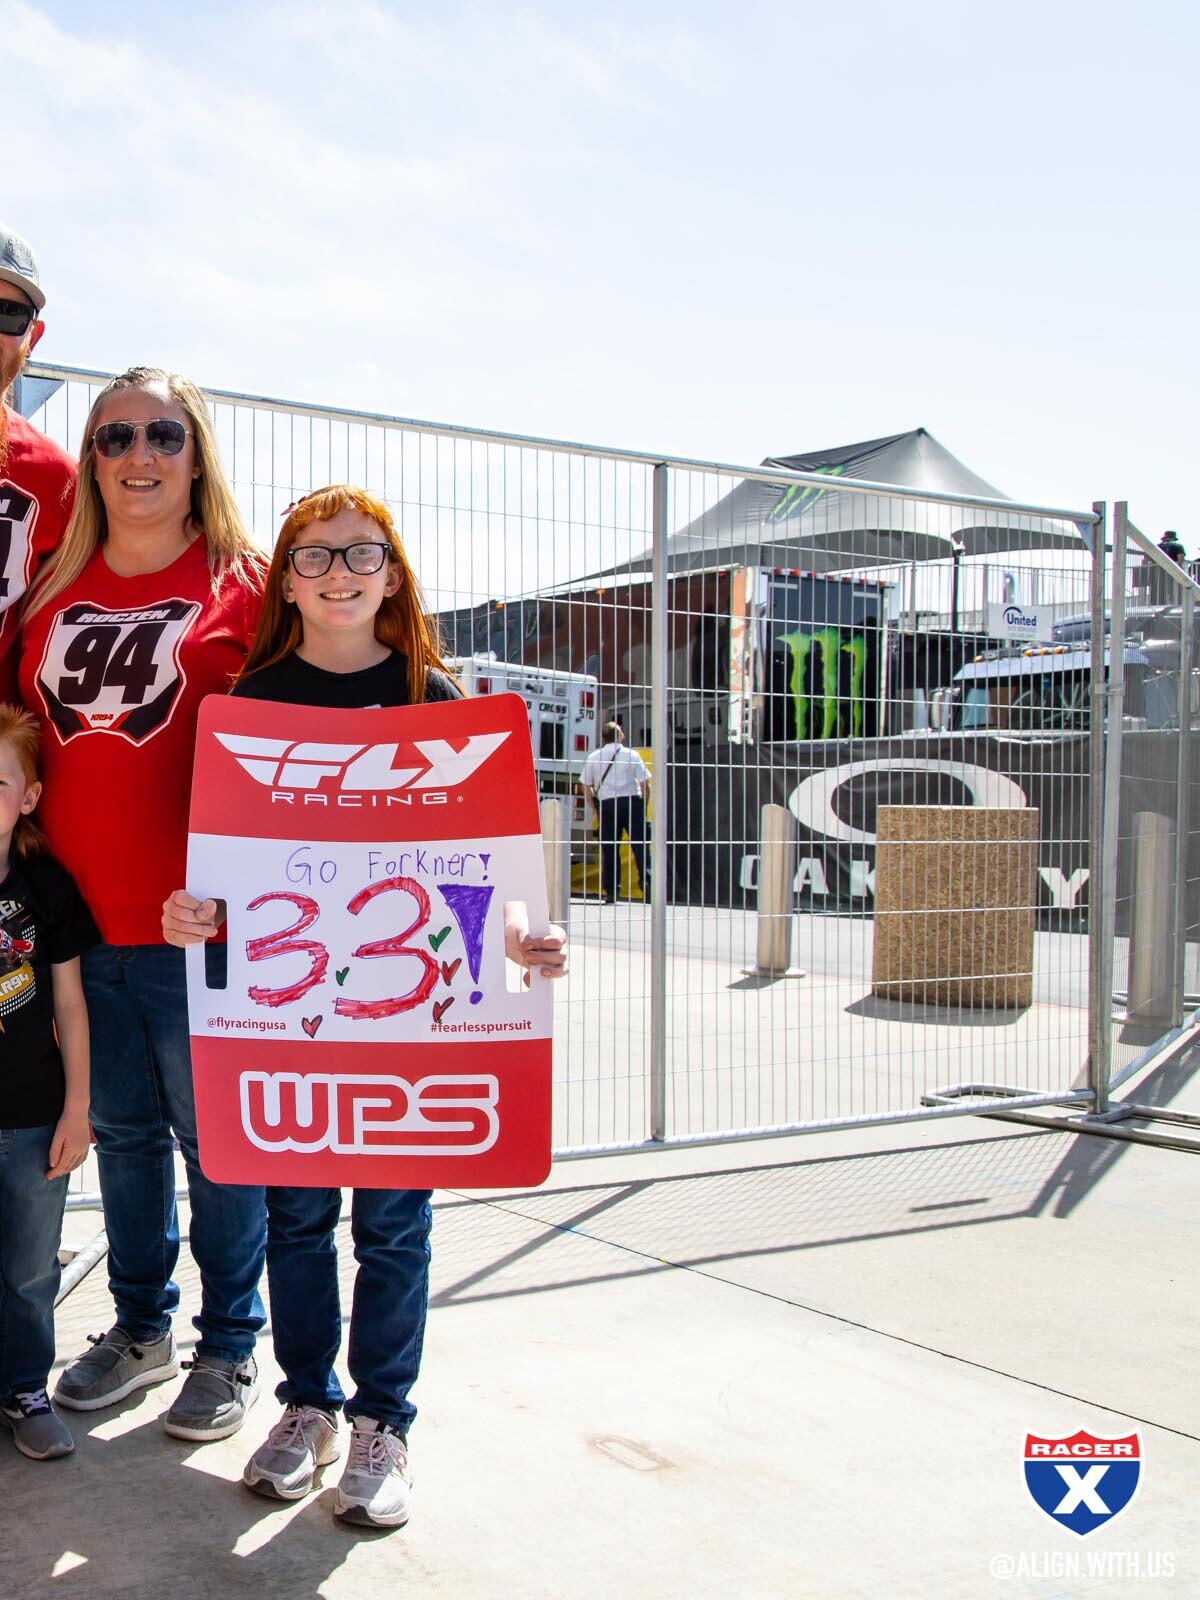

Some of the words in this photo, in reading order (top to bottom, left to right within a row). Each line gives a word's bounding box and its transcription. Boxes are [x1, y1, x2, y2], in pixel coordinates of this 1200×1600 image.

[75, 608, 171, 623] ROCZEN
[1006, 612, 1037, 626] United
[58, 622, 168, 705] 94
[212, 731, 512, 791] FLY
[286, 847, 337, 885] Go
[207, 1016, 287, 1031] @flyracingusa
[430, 1019, 533, 1034] #fearlesspursuit
[239, 1070, 500, 1155] WPS
